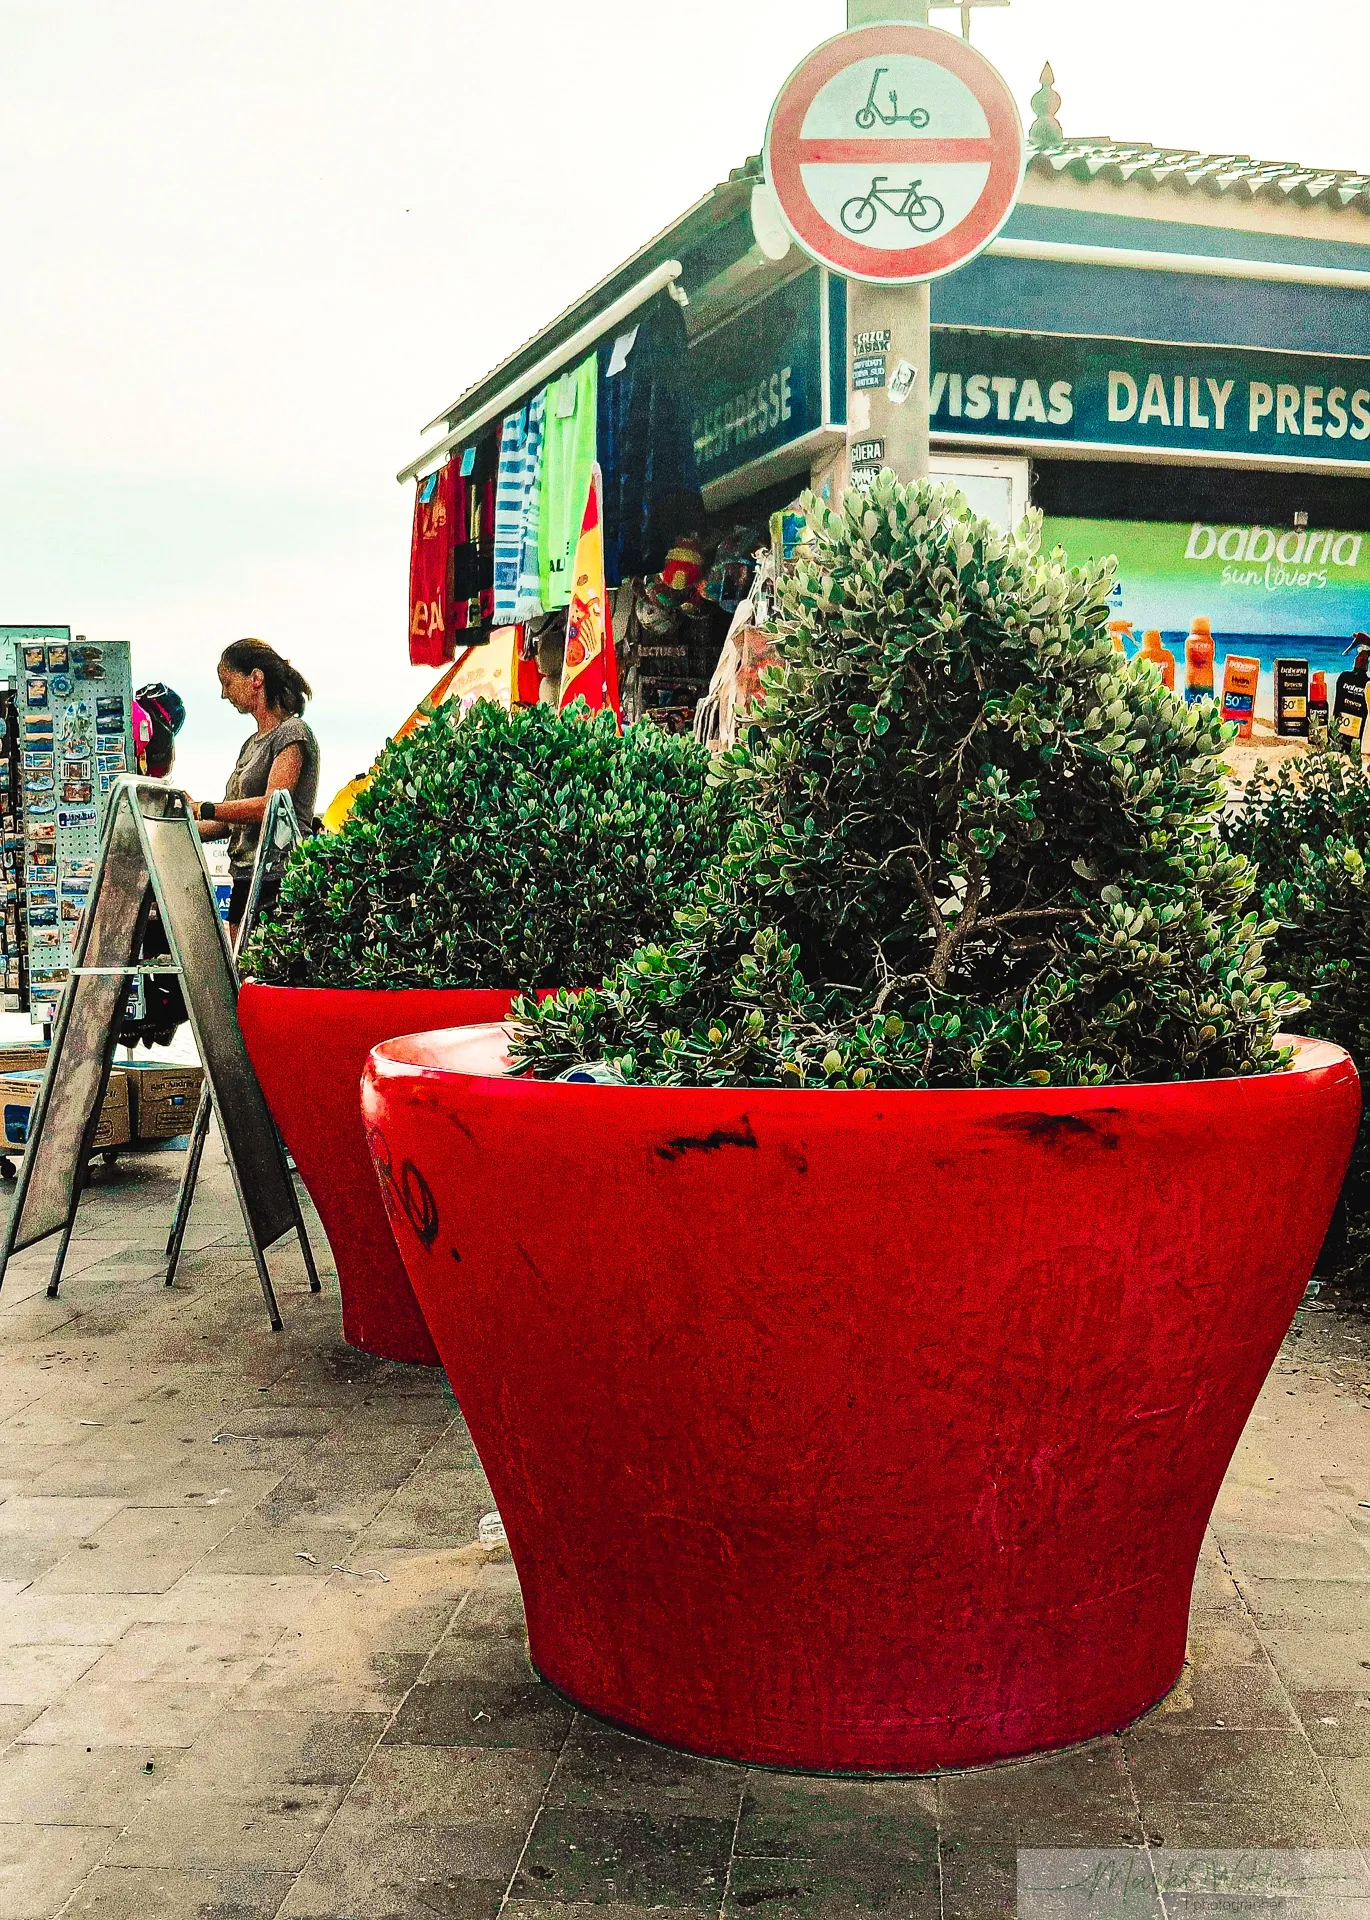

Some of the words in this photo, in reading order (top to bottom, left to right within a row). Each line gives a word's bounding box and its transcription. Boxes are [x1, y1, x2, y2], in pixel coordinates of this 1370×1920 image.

[870, 367, 886, 377] SUD
[1108, 370, 1235, 430] DAILY
[1249, 381, 1370, 441] PRESS
[1184, 522, 1363, 567] babaria
